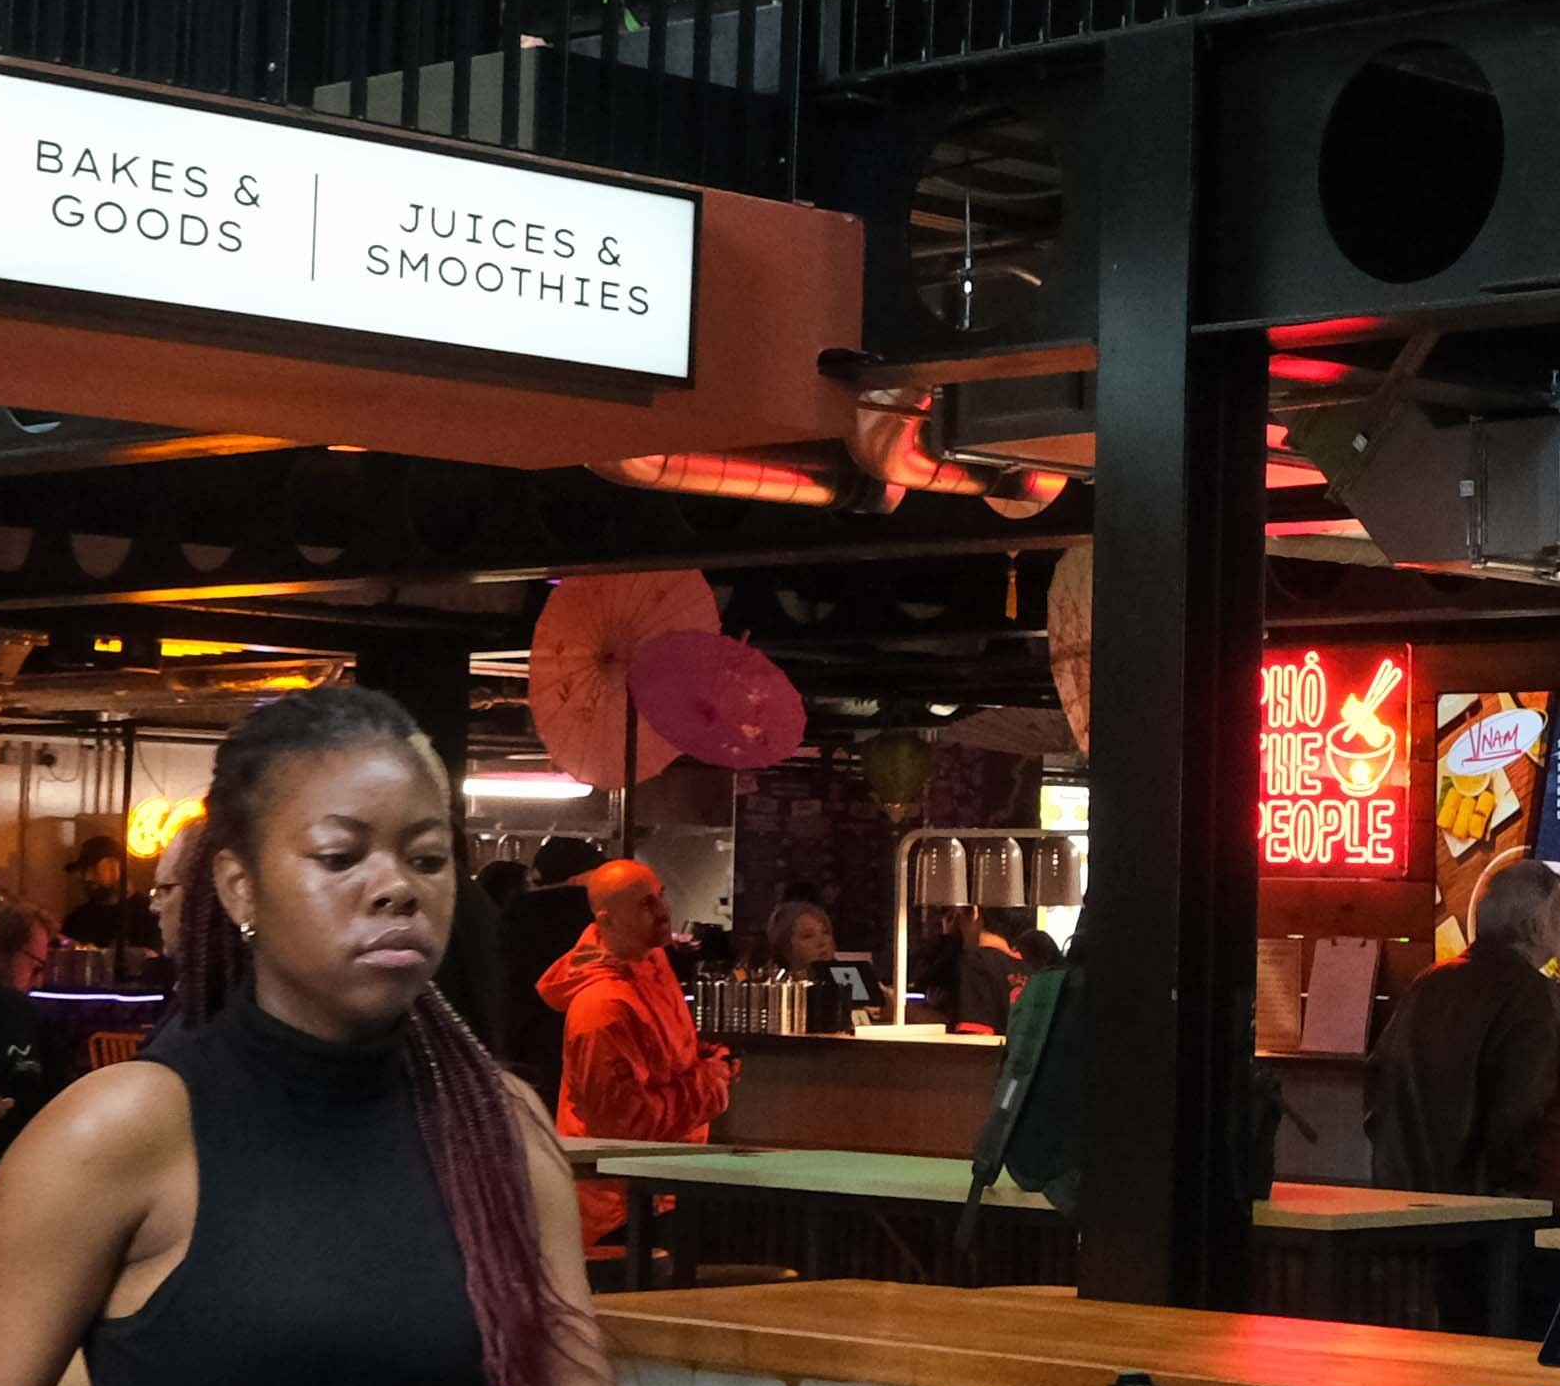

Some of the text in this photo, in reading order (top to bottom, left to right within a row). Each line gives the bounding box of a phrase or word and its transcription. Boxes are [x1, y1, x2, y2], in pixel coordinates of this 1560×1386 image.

[36, 139, 261, 208] BAKES &
[51, 195, 243, 253] GOODS
[399, 203, 621, 268] JUICES &
[364, 244, 649, 317] SMOOTHIES
[1259, 732, 1323, 795] HE
